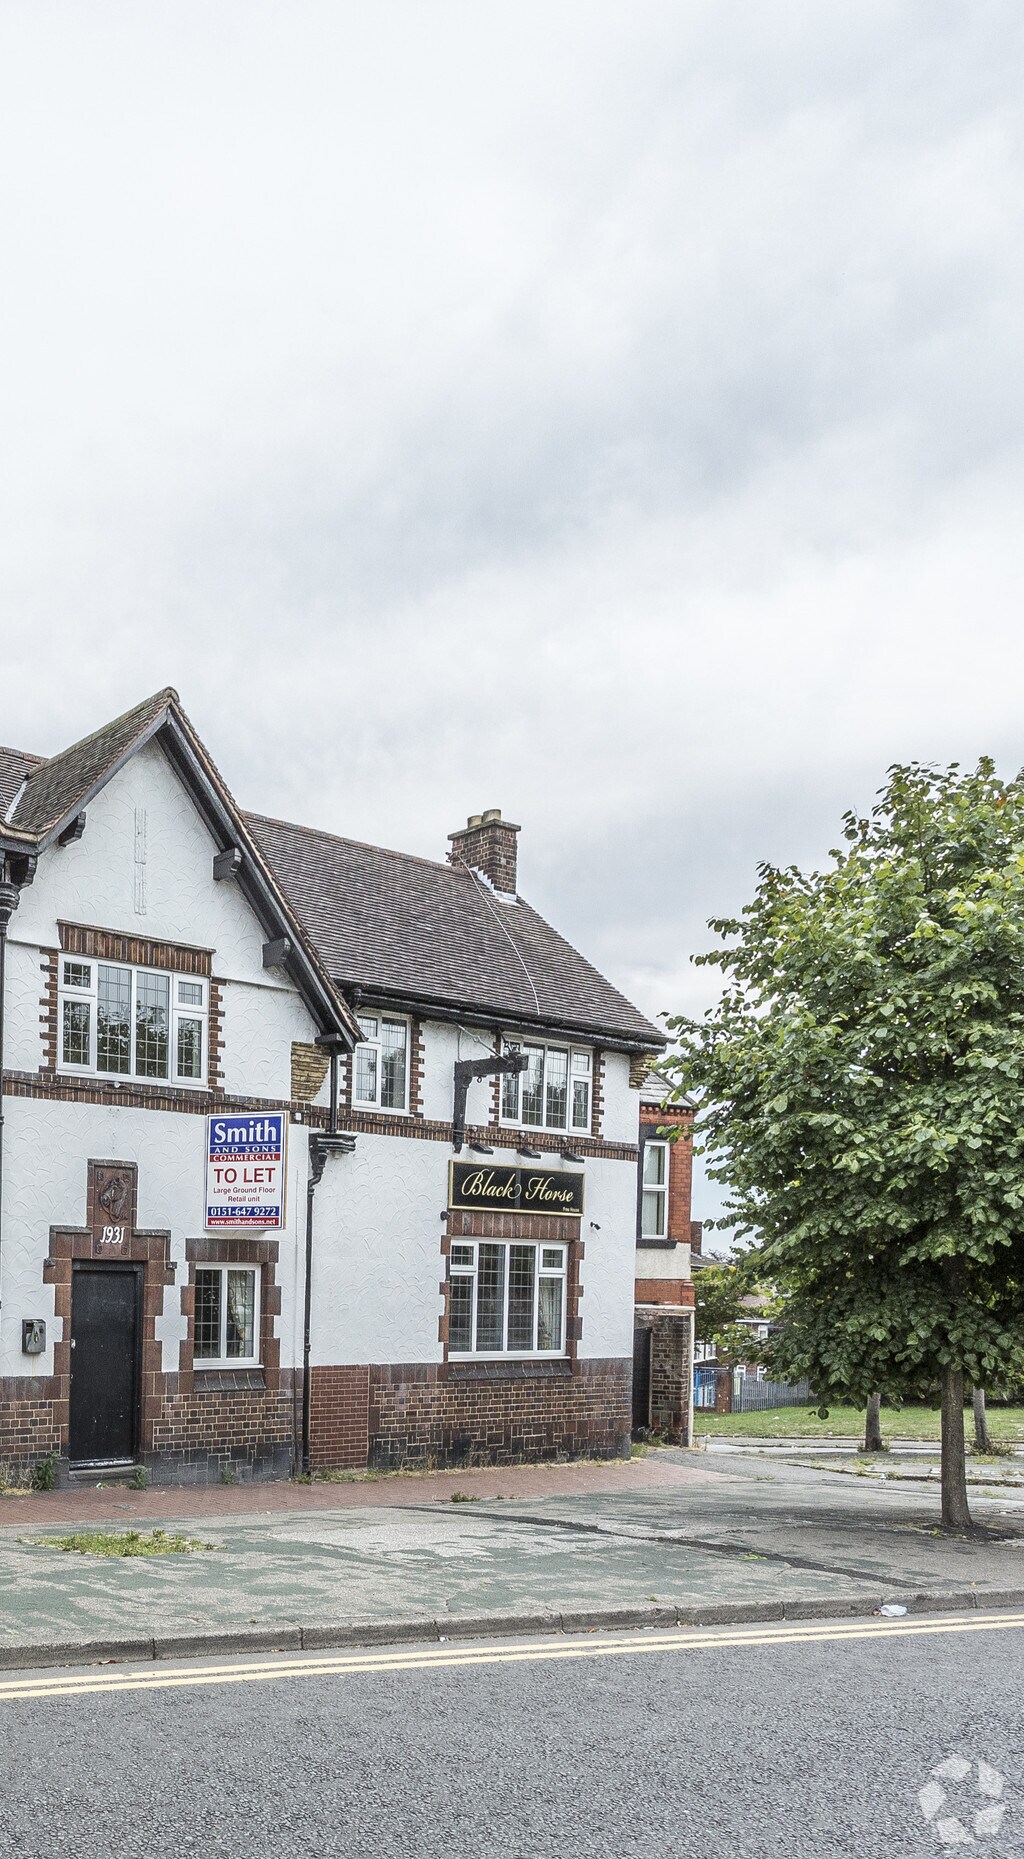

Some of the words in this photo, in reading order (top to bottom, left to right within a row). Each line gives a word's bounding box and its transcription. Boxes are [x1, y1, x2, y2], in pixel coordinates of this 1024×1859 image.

[214, 1119, 276, 1143] Smith
[245, 1145, 276, 1153] SONS
[213, 1168, 237, 1183] TO
[243, 1167, 276, 1183] LET
[213, 1187, 231, 1195] Large
[461, 1168, 522, 1199] Black
[525, 1176, 574, 1202] Horse
[210, 1207, 251, 1216] 0151-647
[254, 1207, 276, 1216] 9272
[100, 1226, 125, 1244] 1931
